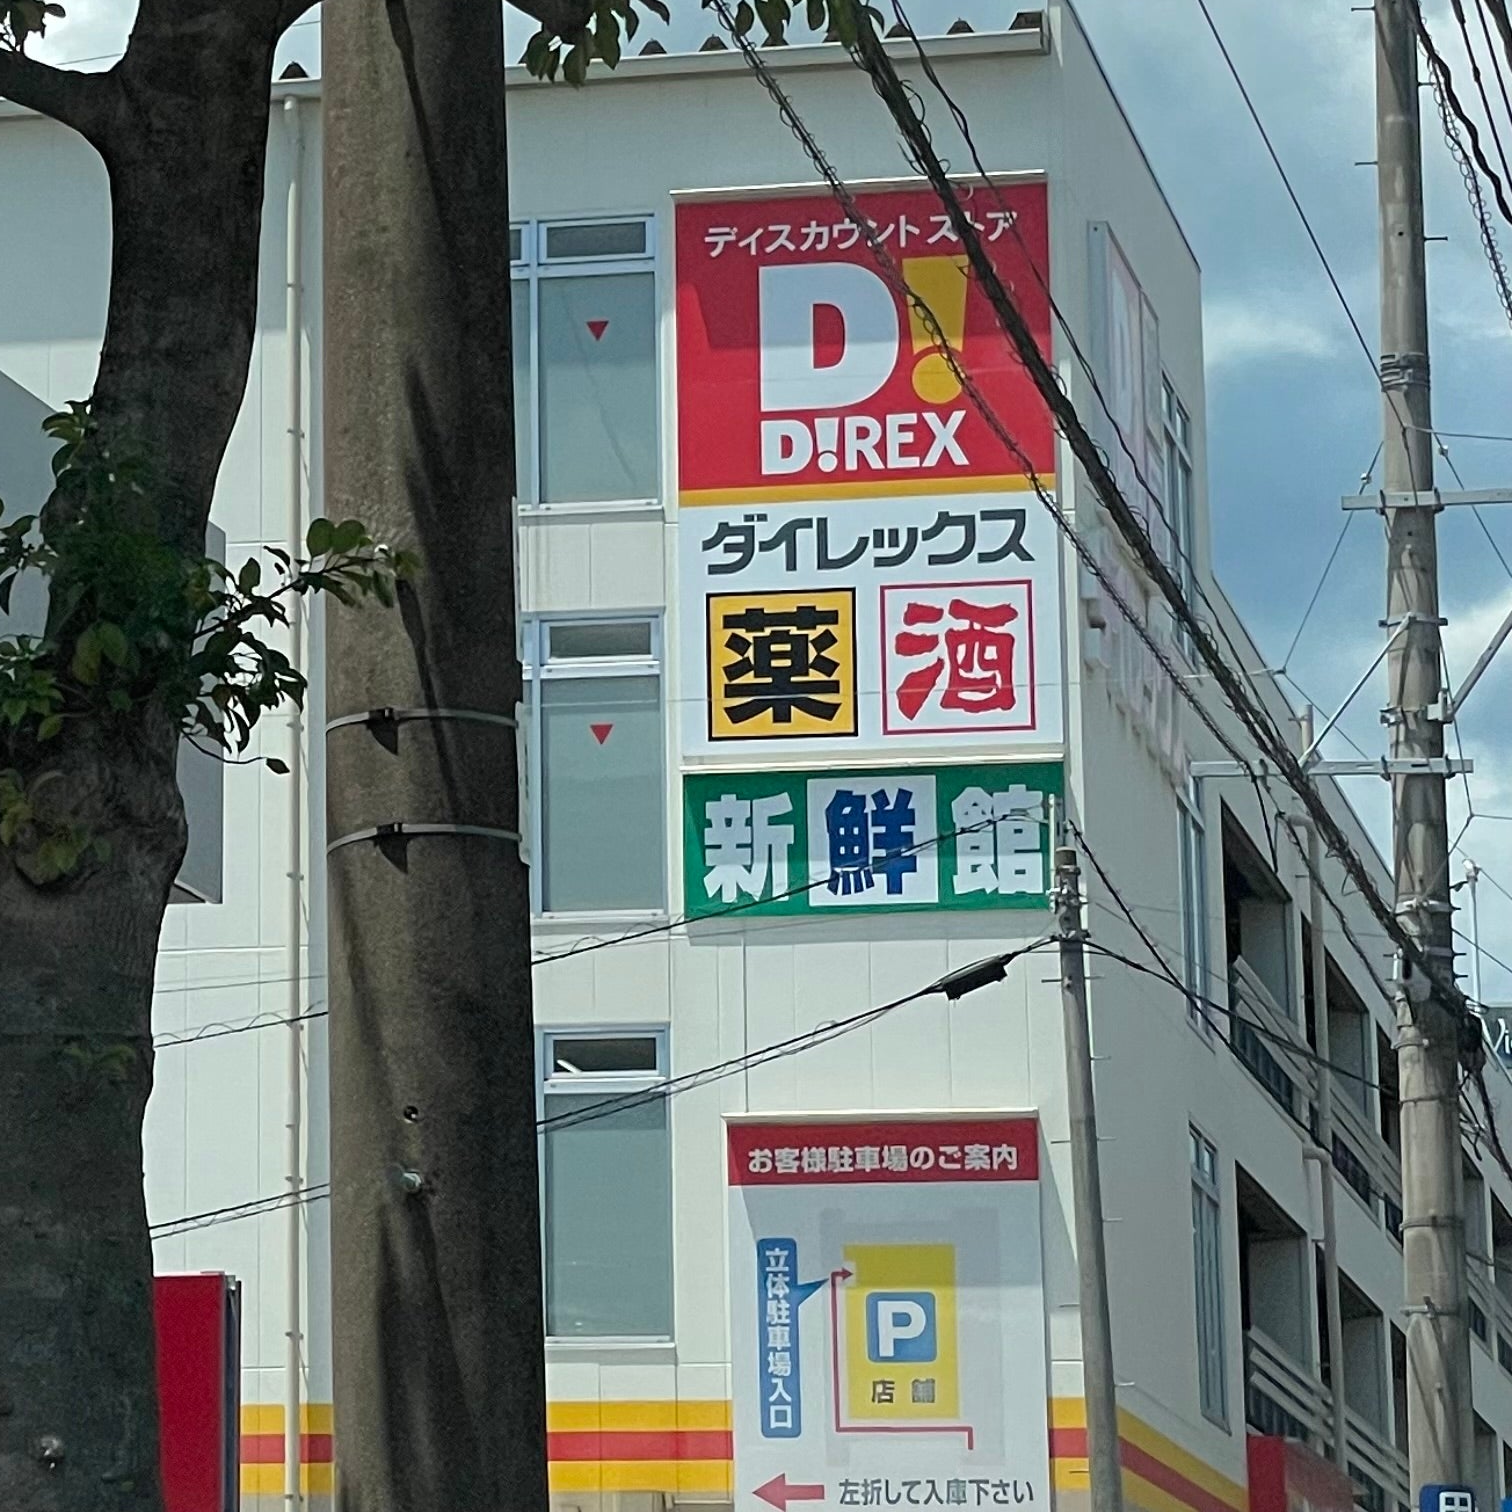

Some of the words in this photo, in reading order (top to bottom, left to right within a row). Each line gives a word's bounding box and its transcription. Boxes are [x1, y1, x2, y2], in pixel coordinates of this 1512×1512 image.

[761, 410, 970, 475] D!REX
[702, 508, 1036, 575] ダイレックス
[722, 605, 842, 724] 薬
[895, 599, 1019, 721] 酒
[703, 785, 1044, 903] 新鮮館
[748, 1144, 1018, 1174] お客様駐車場のご案内
[765, 1248, 792, 1429] 立体駐車場入口
[877, 1301, 927, 1357] P
[838, 1478, 1034, 1506] 左折して入庫下さい
